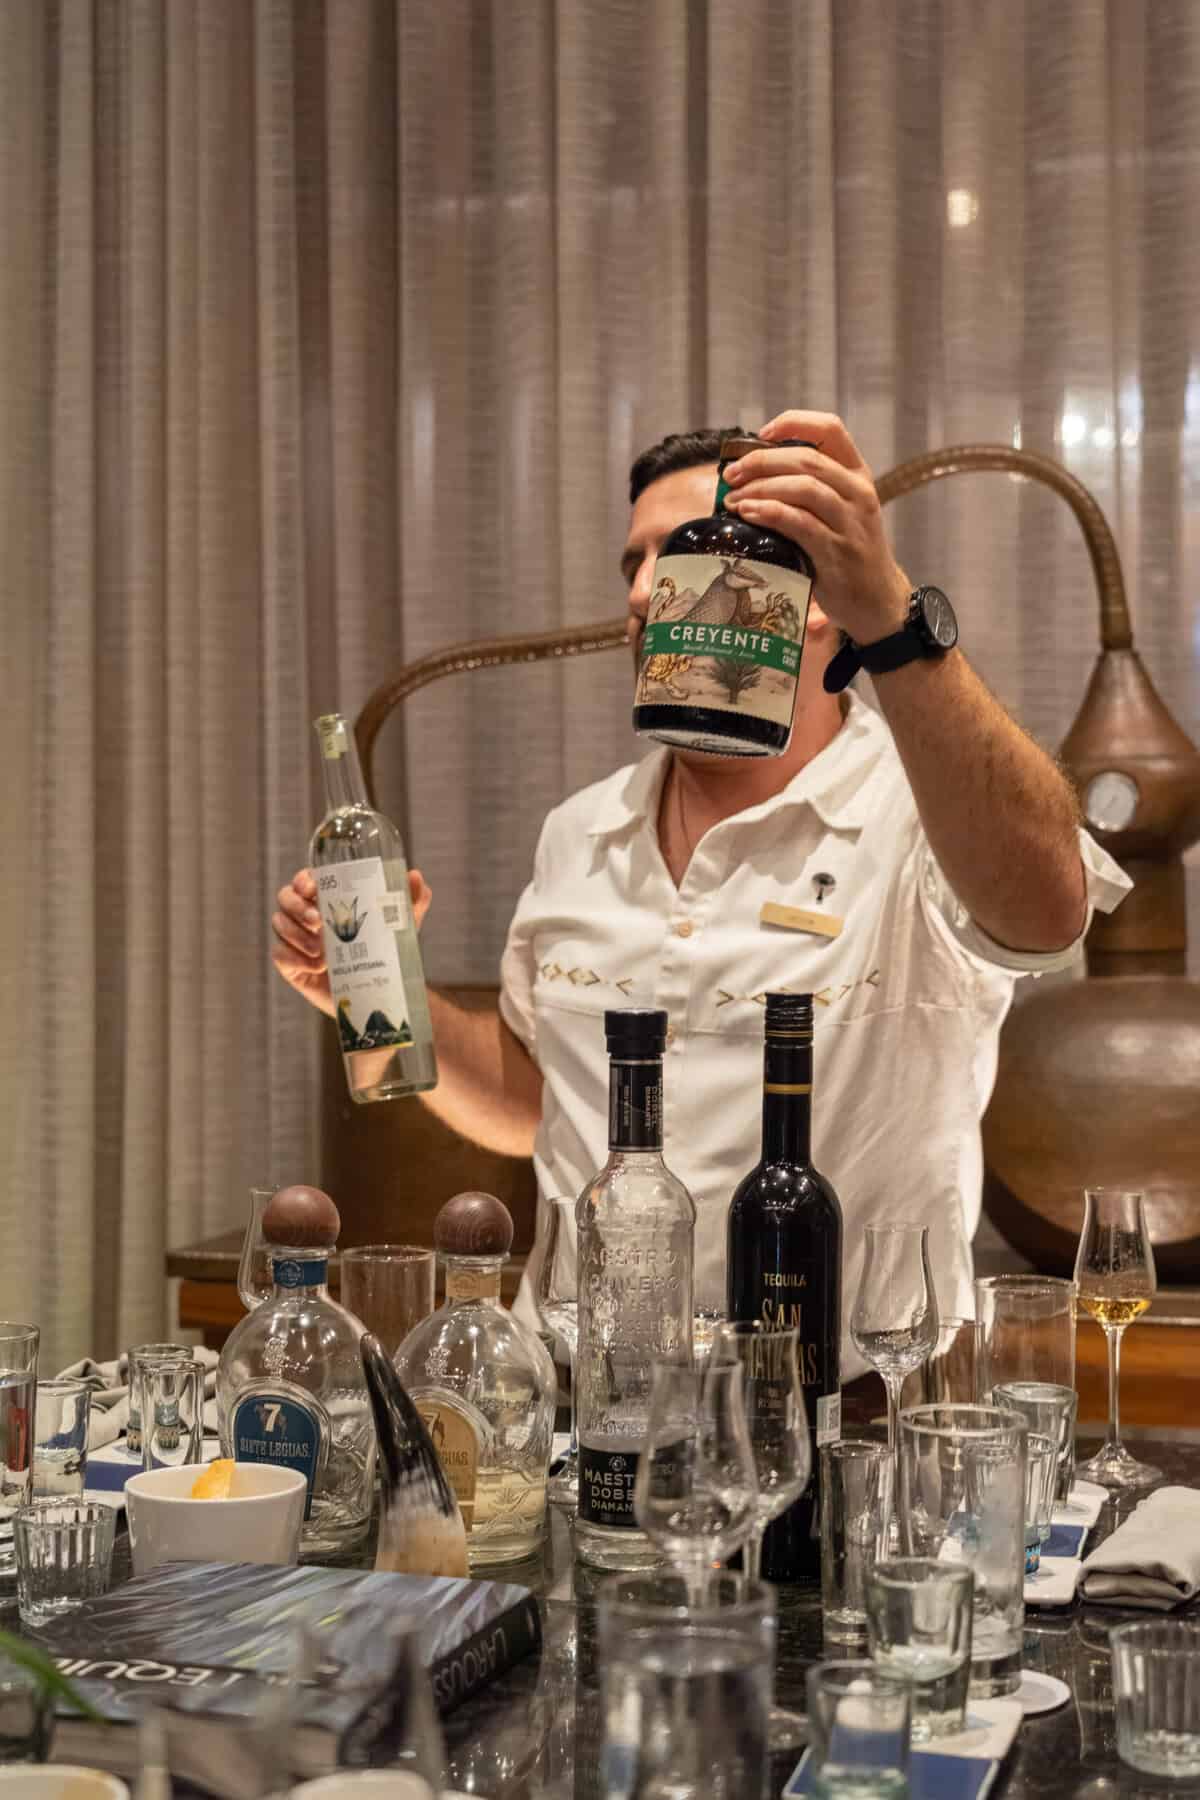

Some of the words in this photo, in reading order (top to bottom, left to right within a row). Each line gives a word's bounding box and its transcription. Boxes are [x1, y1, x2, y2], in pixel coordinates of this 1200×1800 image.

[669, 625, 771, 653] CREYENTE
[763, 1272, 807, 1288] TEQUILA
[263, 1402, 282, 1433] 7
[585, 1466, 635, 1487] MAEST
[591, 1485, 636, 1502] DOBE
[591, 1498, 634, 1514] DIAMAN
[432, 1627, 507, 1697] LAROUSS
